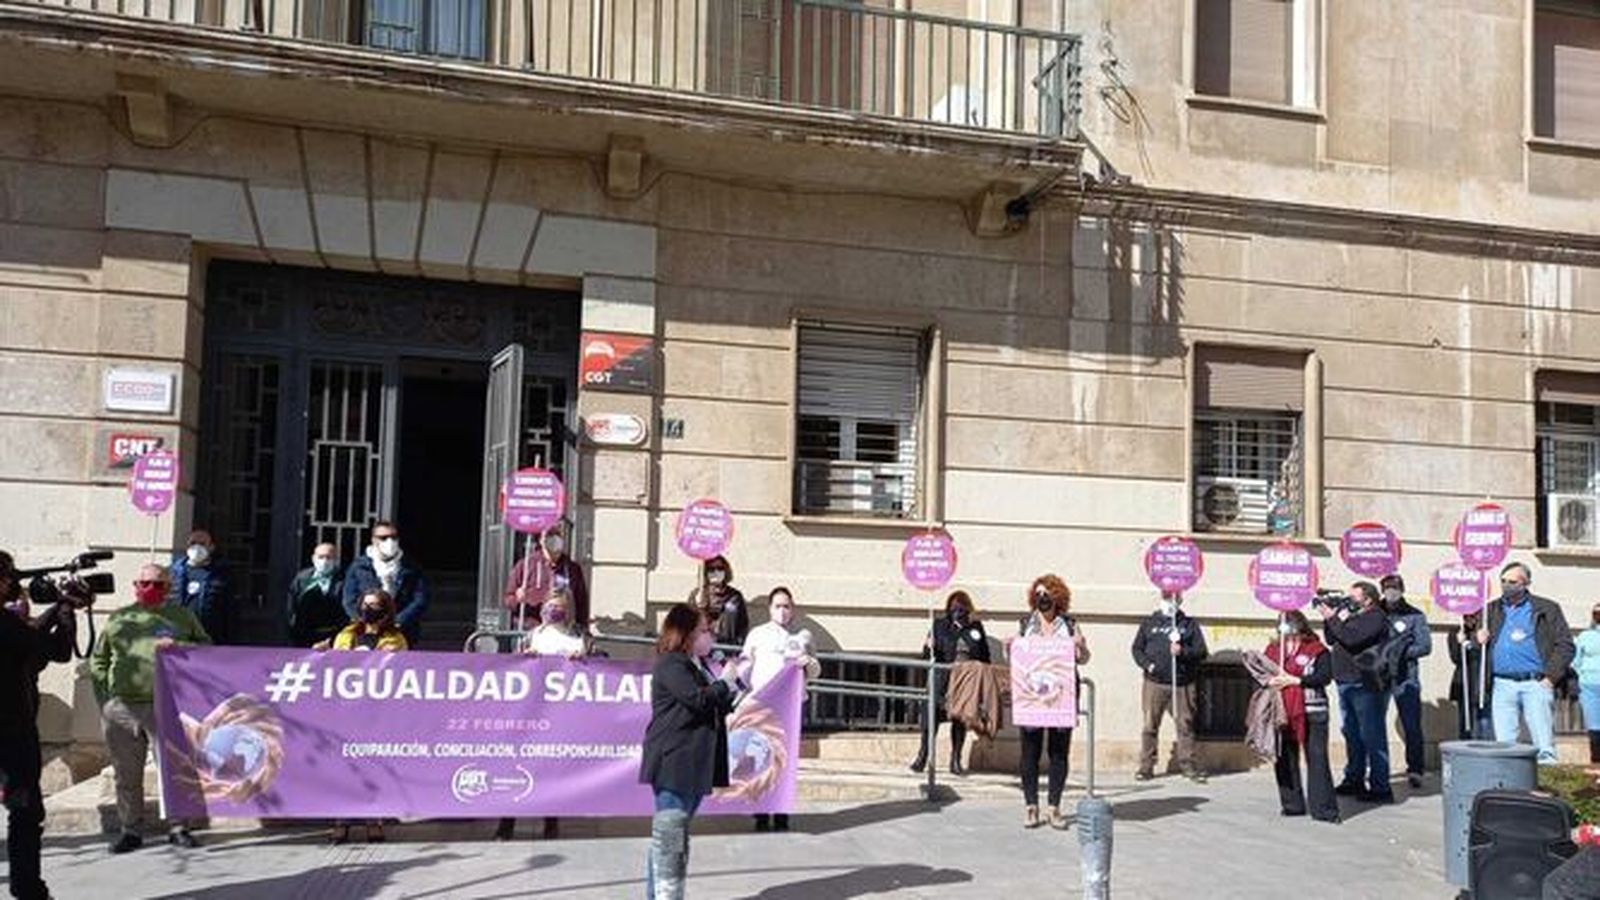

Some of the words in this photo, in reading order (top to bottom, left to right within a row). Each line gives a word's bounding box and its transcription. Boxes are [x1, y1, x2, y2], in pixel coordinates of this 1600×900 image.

[585, 371, 612, 384] CGT
[114, 437, 158, 457] CNT
[447, 718, 468, 731] 22
[474, 719, 551, 732] FEBRERO
